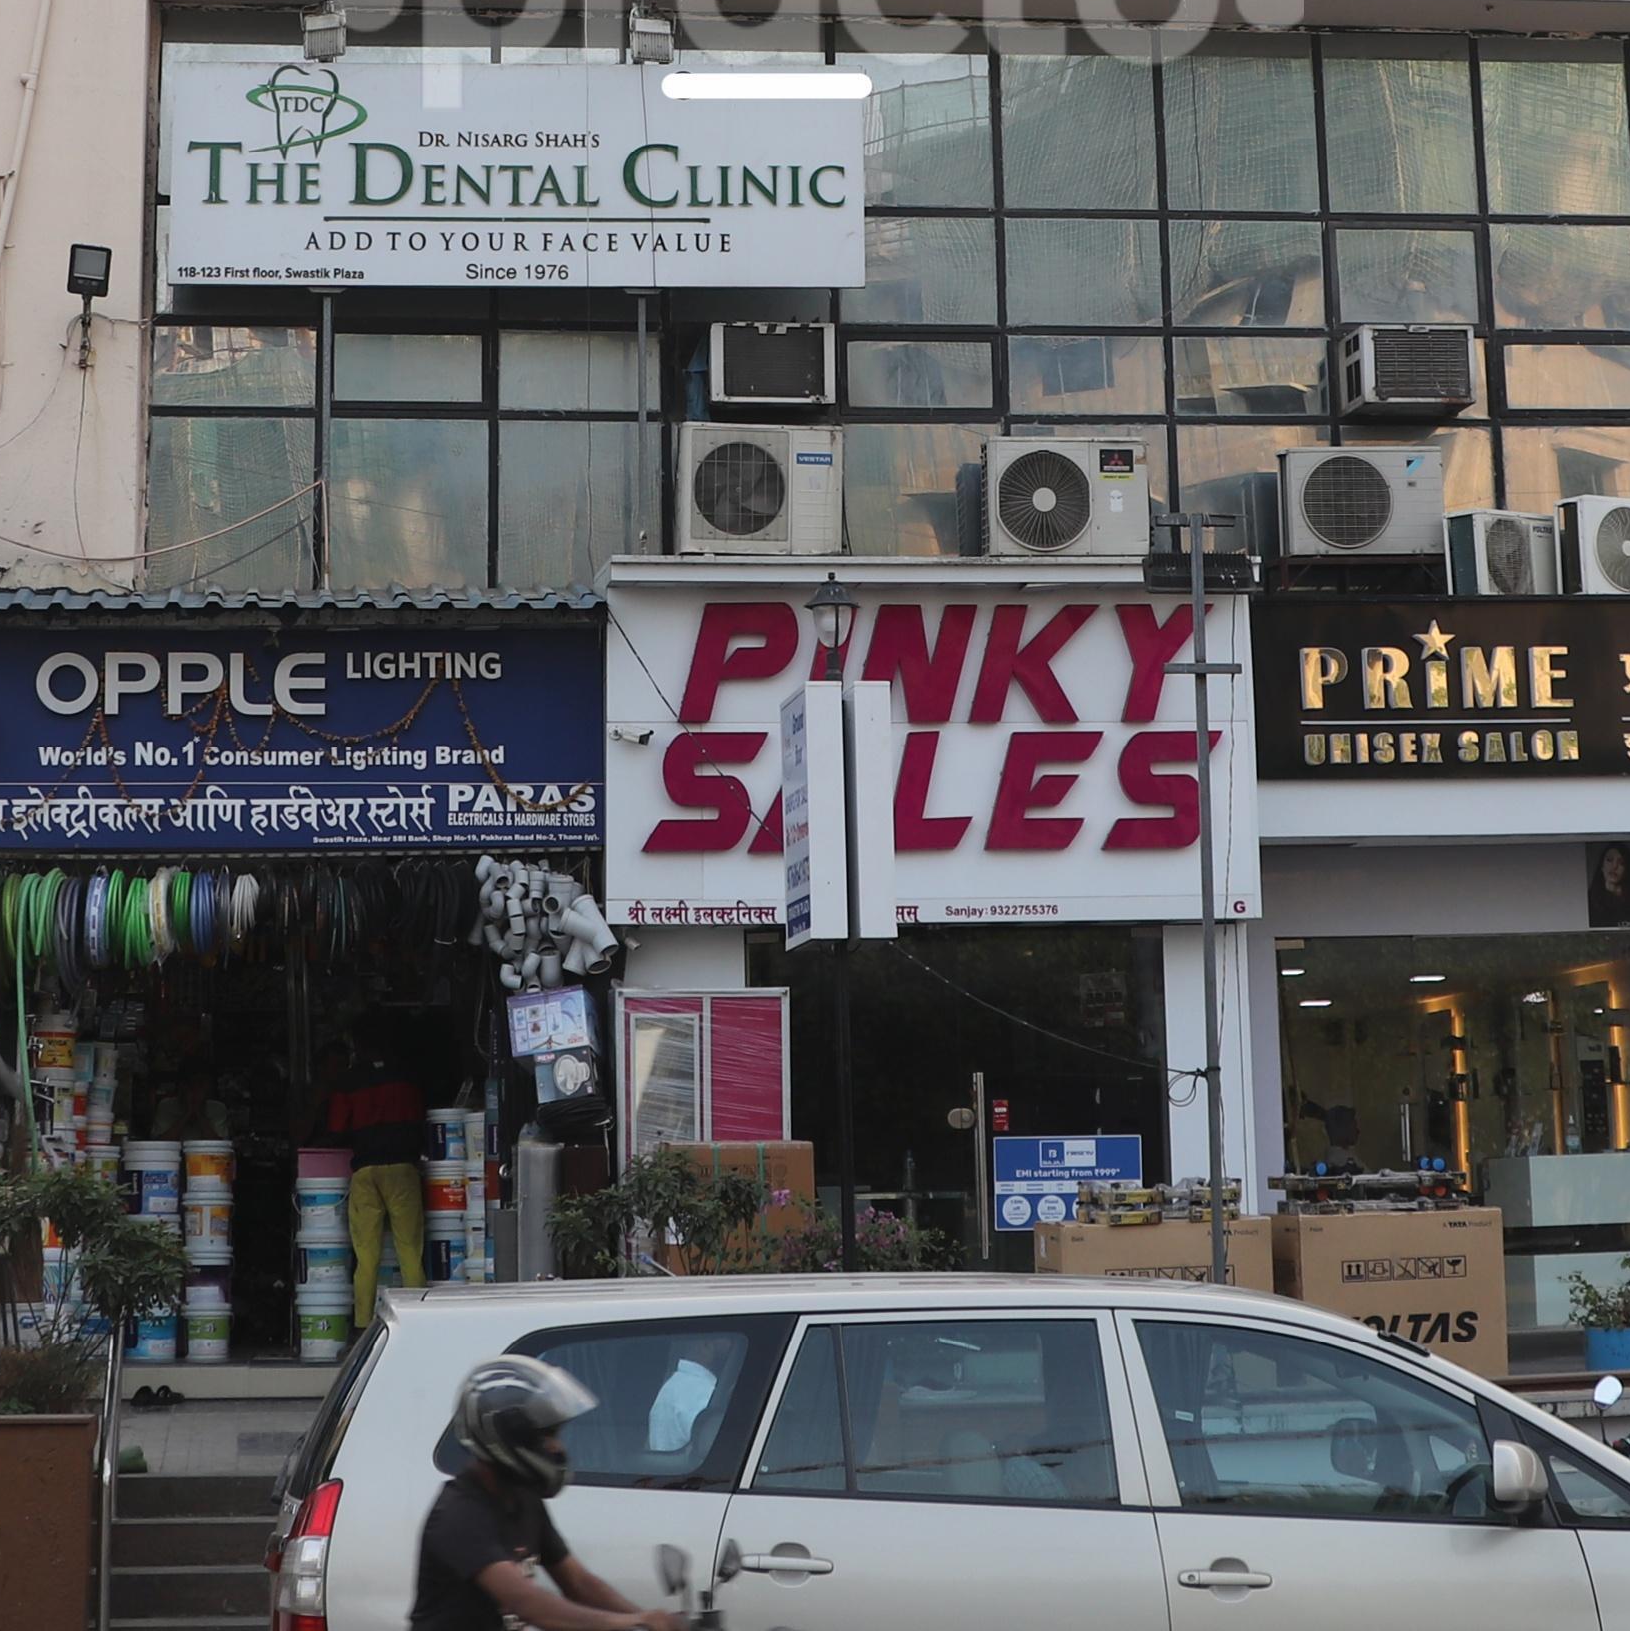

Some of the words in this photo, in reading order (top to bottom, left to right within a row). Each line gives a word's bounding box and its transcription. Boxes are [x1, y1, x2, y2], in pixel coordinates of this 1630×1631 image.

[280, 95, 325, 115] TDC
[305, 232, 374, 254] ADD
[389, 232, 427, 254] TO
[440, 232, 530, 254] YOUR
[541, 232, 620, 254] FACE
[630, 232, 733, 255] VALUE
[176, 266, 222, 279] 118-123
[224, 266, 250, 280] First
[252, 266, 283, 281] floor,
[285, 266, 331, 280] Swastik
[332, 267, 365, 281] Plaza
[465, 264, 517, 281] Since
[523, 264, 570, 281] 1976
[36, 651, 326, 717] OPPLE
[345, 651, 502, 680] LIGHTING
[38, 746, 127, 768] World's
[205, 747, 325, 768] Consumer
[330, 746, 428, 771] Lighting
[434, 745, 505, 765] Brand
[1304, 732, 1444, 766] UNISEX
[1457, 730, 1581, 763] SALON
[448, 784, 596, 812] PARAS
[642, 730, 1223, 853] SLES
[168, 785, 247, 832] आणि
[447, 813, 504, 826] ELECTRICALS
[514, 813, 561, 826] HARDWARE
[563, 813, 595, 826] STORES
[628, 900, 646, 924] श्री
[651, 899, 690, 925] लक्ष्मी
[990, 904, 1058, 916] 9322755376
[1016, 1170, 1032, 1178] EMI
[1033, 1170, 1069, 1179] starting
[1071, 1169, 1092, 1177] from
